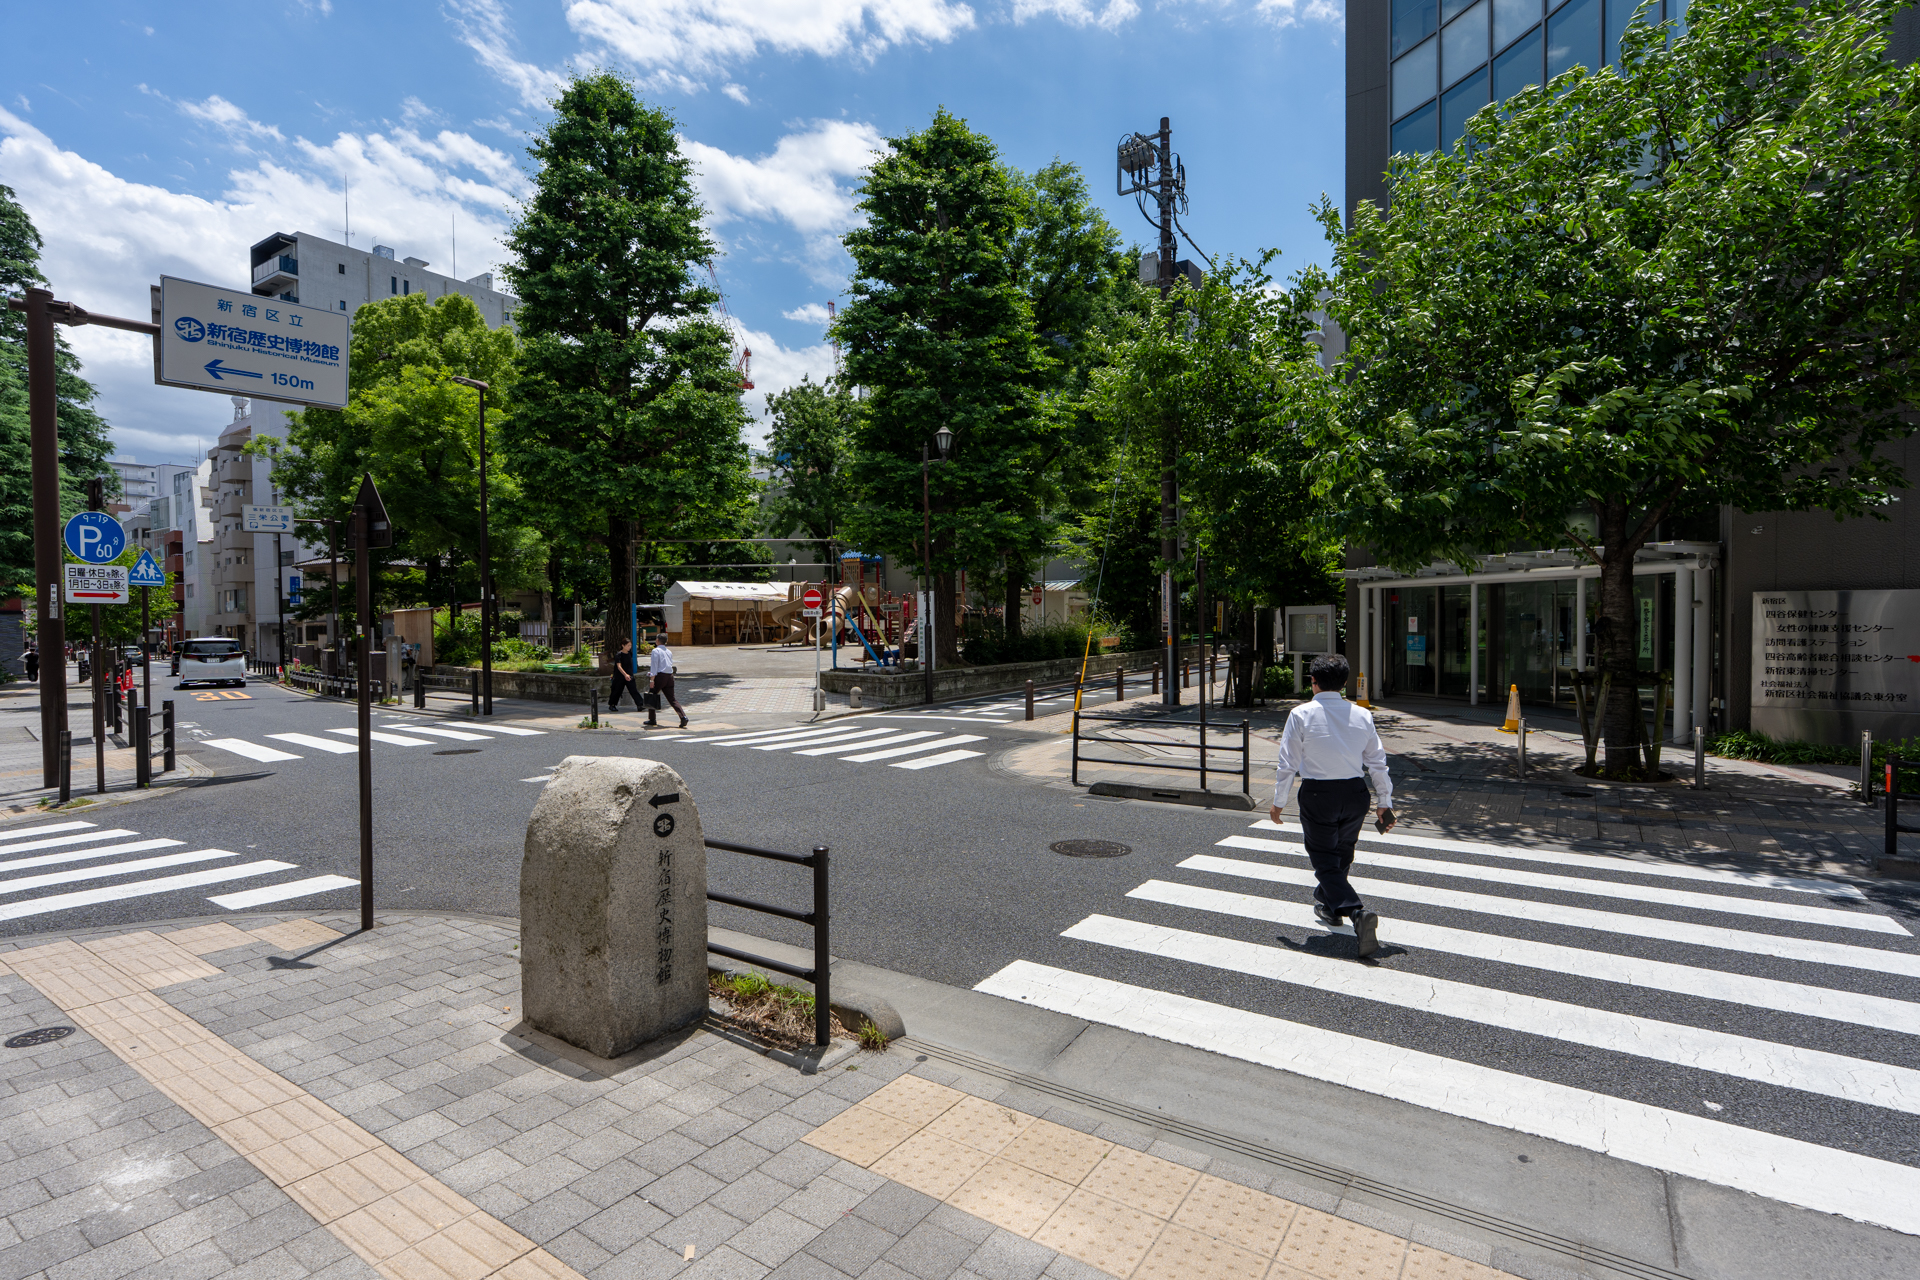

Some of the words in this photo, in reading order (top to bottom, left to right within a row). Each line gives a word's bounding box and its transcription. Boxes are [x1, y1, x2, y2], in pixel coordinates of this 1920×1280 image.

[217, 299, 303, 327] 新宿区立
[207, 322, 340, 361] 新宿歴史博物館
[207, 339, 250, 352] Shinjuku
[252, 347, 298, 360] Historical
[300, 356, 340, 367] Museum
[270, 372, 315, 390] 150m
[82, 514, 109, 524] 9-19
[248, 513, 290, 522] 三栄公園
[79, 525, 102, 557] P
[1761, 597, 1787, 605] 新宿区
[1765, 610, 1849, 619] 四谷保健センター
[1776, 624, 1894, 633] 女性の健康支援センター
[1765, 638, 1868, 647] 訪問看護ステーション
[1765, 653, 1905, 663] 四谷高齢者総合相談センター
[1764, 666, 1859, 676] 新宿東清掃センター
[1760, 680, 1811, 689] 社会福祉法人
[190, 690, 253, 701] 30
[1764, 689, 1908, 702] 新宿区社会福祉協議会東分室
[655, 849, 673, 986] 新宿歴史博物館
